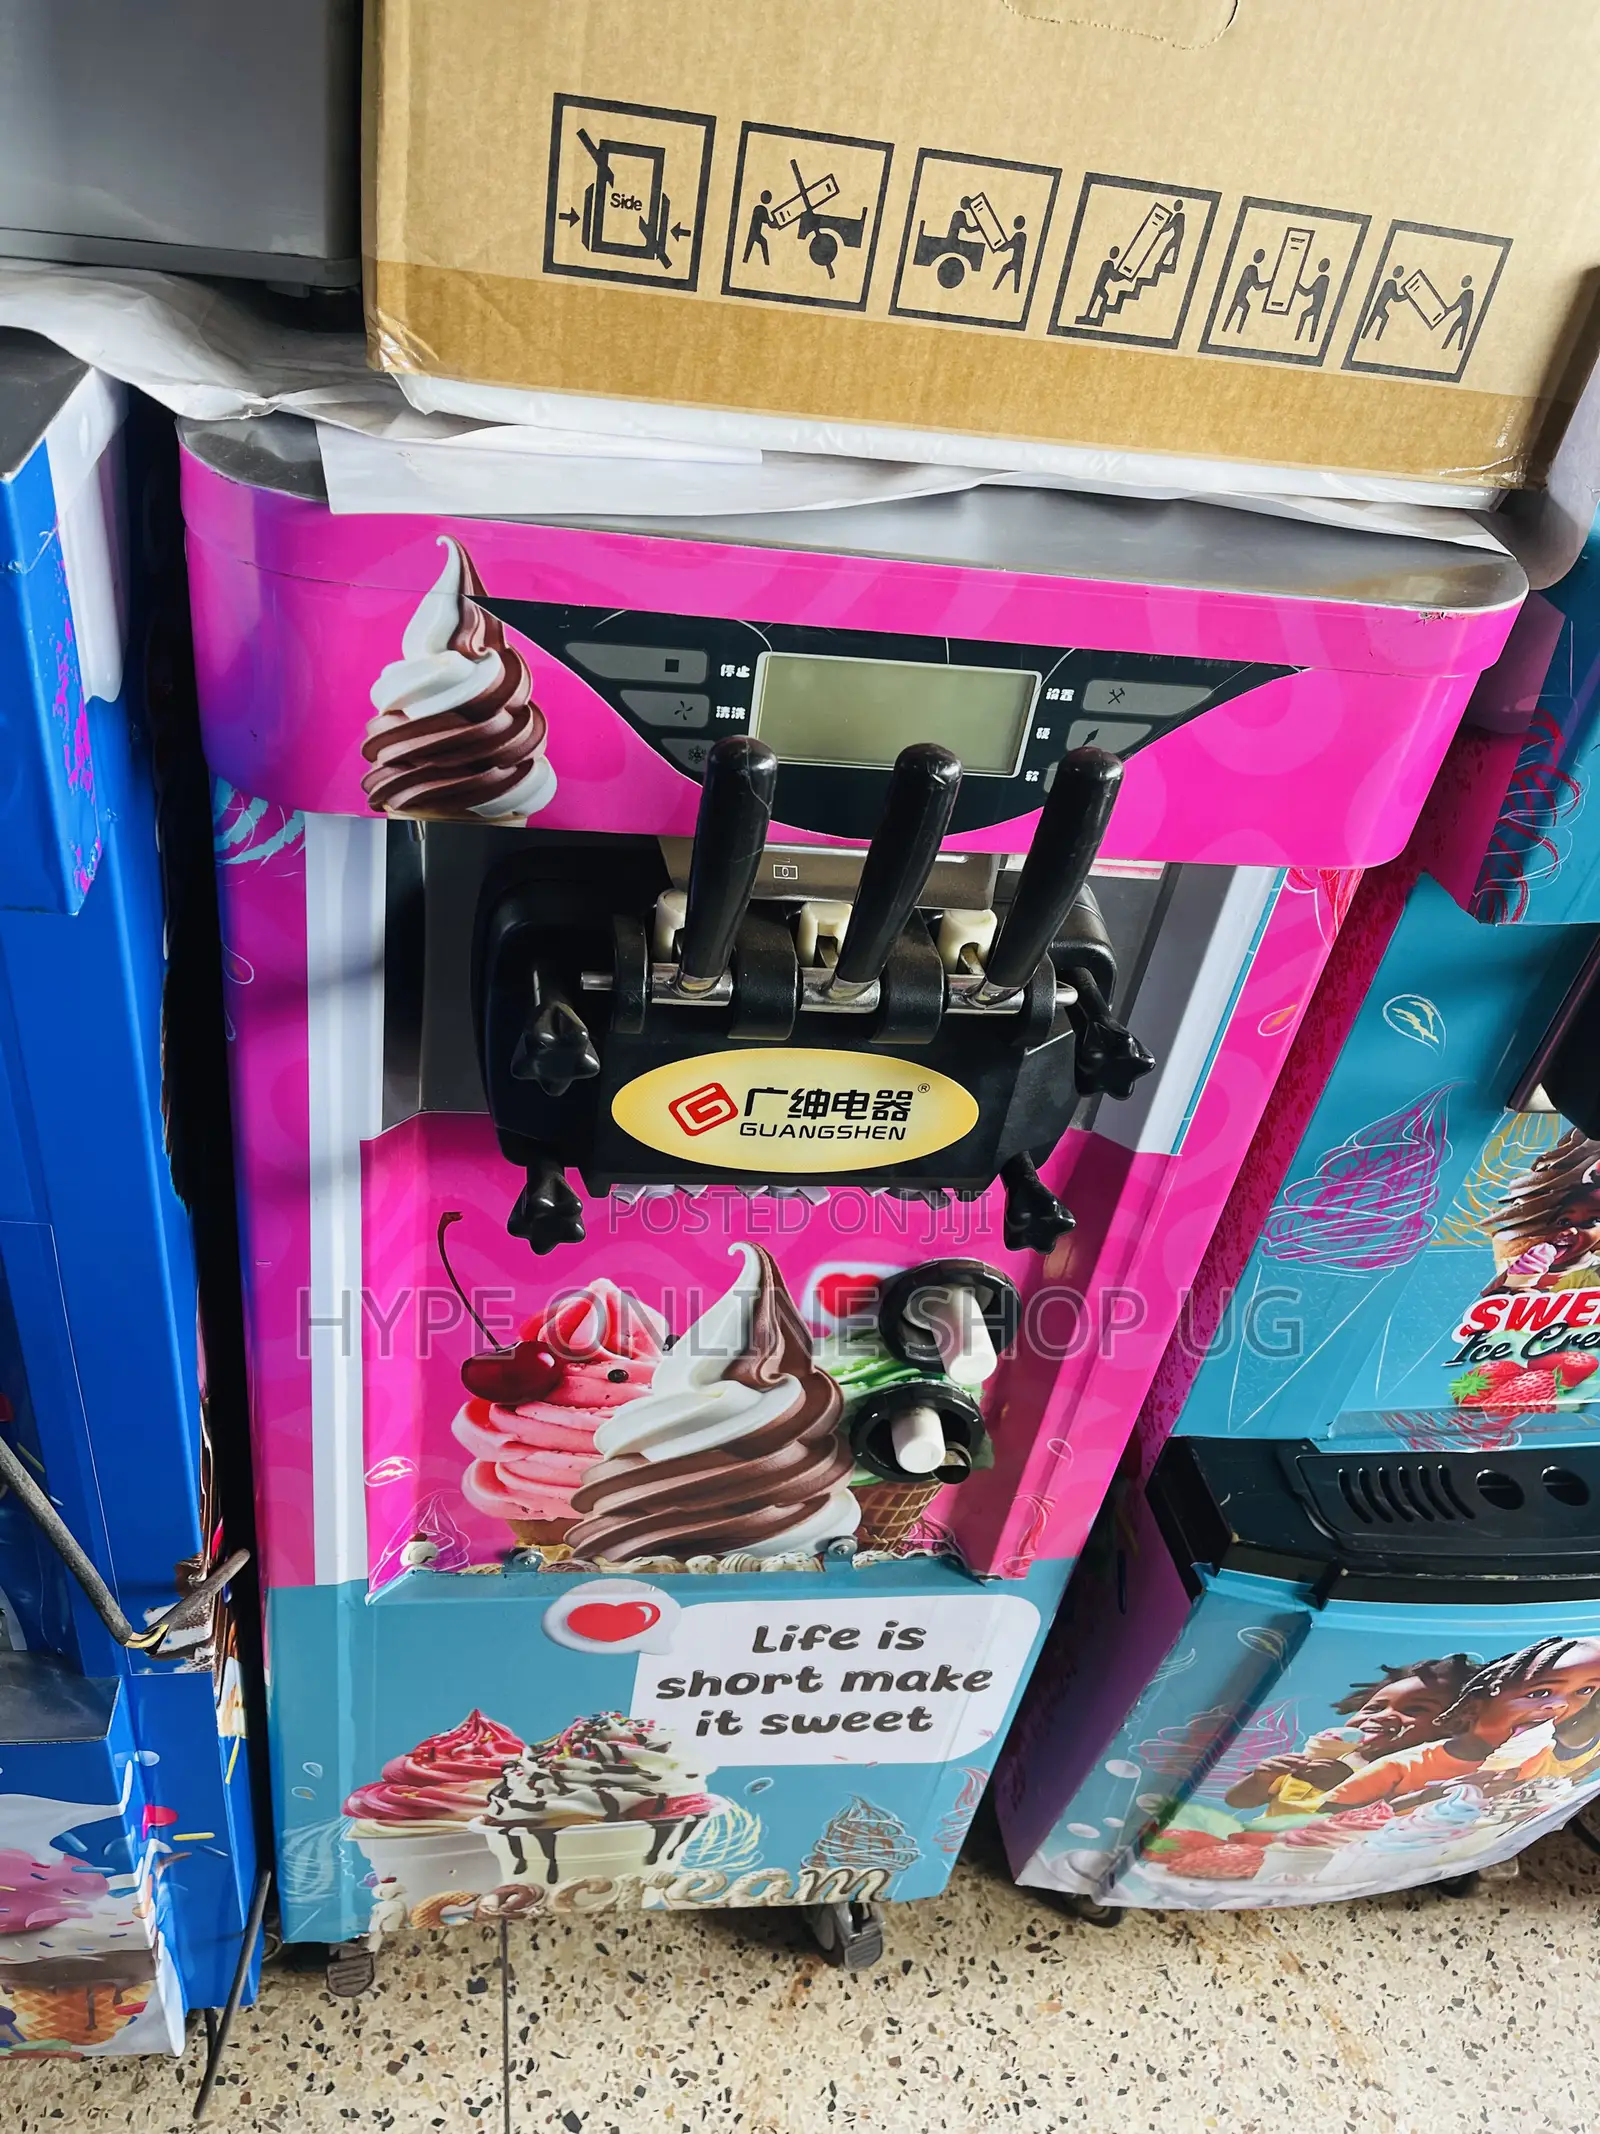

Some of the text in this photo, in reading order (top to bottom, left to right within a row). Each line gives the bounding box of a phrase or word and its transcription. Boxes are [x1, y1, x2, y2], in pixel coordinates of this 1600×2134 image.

[610, 192, 643, 212] Side
[720, 663, 751, 678] 停止
[715, 705, 746, 720] 清洗
[744, 1086, 914, 1122] 广绅电器
[739, 1122, 907, 1141] GUANGSHEN
[1459, 1291, 1600, 1337] SWE
[1442, 1329, 1513, 1366] Ice
[751, 1620, 927, 1653] Life is
[656, 1664, 993, 1699] short make
[696, 1706, 934, 1737] it sweet
